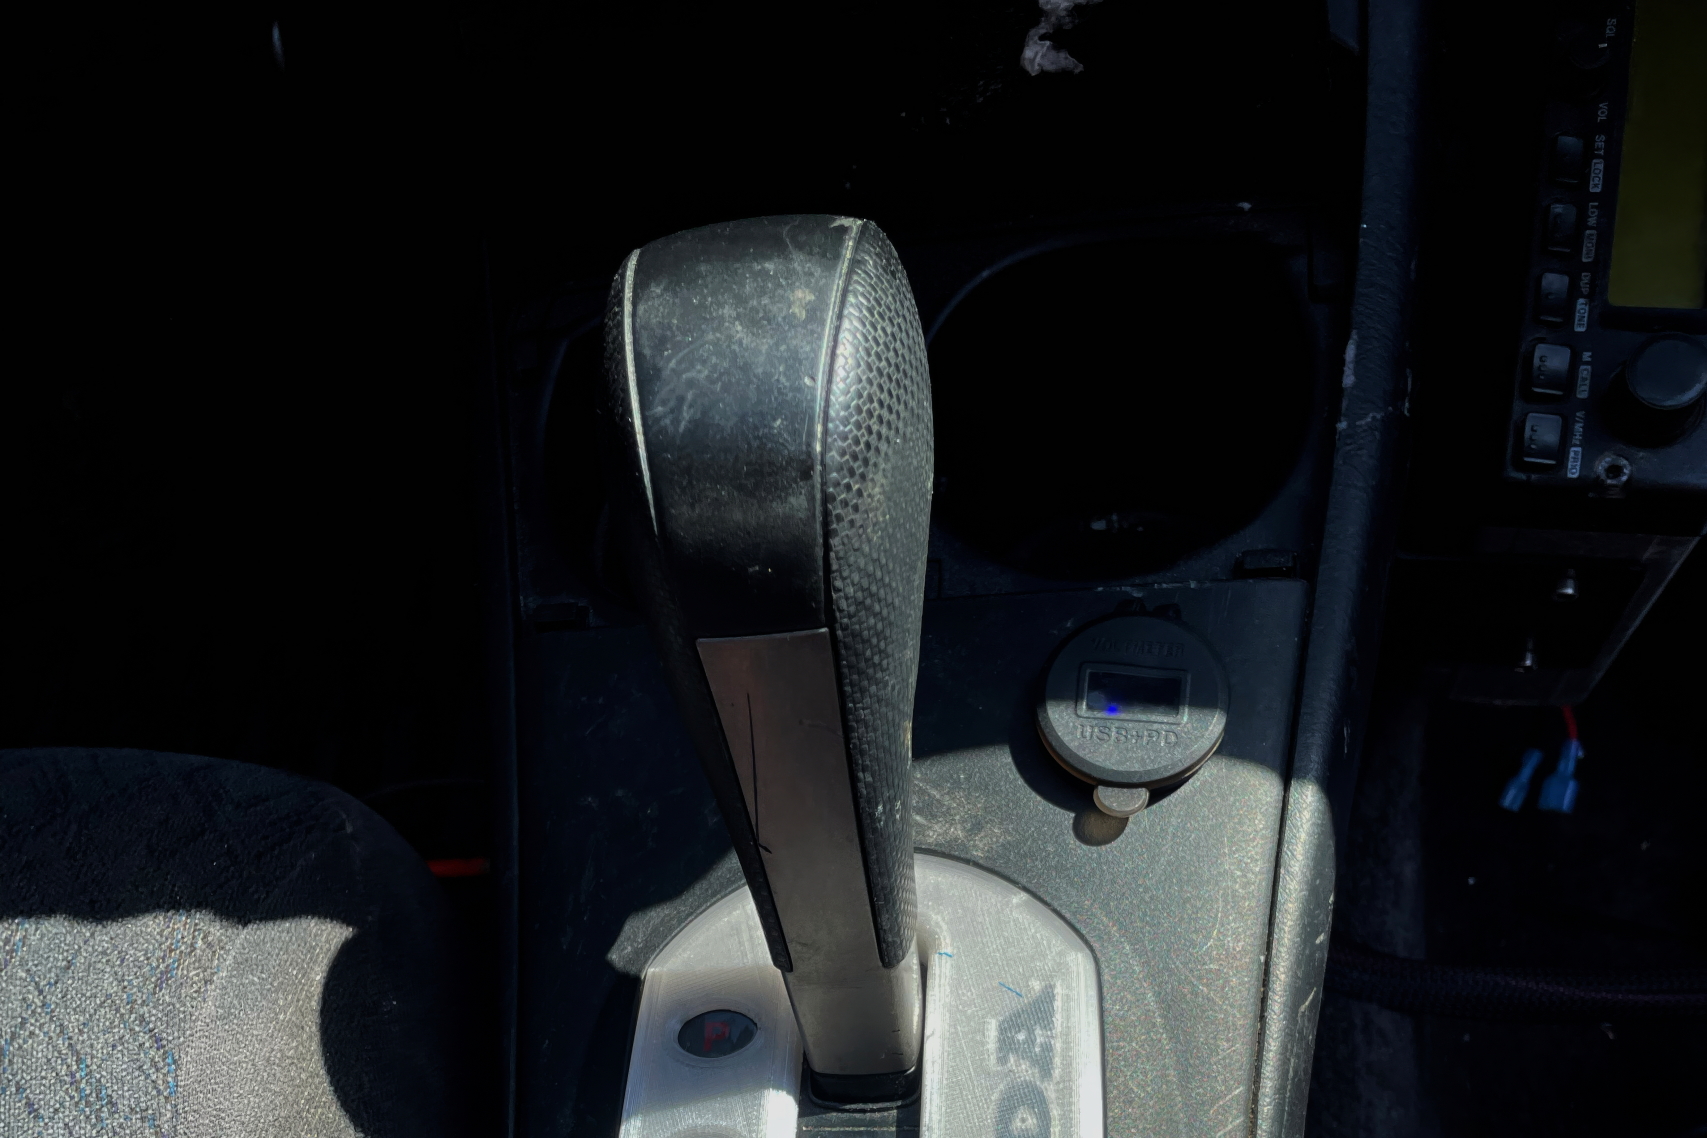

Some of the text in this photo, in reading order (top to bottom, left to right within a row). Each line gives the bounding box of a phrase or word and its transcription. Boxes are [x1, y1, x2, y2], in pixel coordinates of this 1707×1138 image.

[1597, 102, 1609, 123] VOL
[1591, 134, 1606, 190] SET LOCK
[1587, 202, 1599, 227] LOW
[1575, 301, 1589, 330] TONE
[702, 1021, 729, 1052] P
